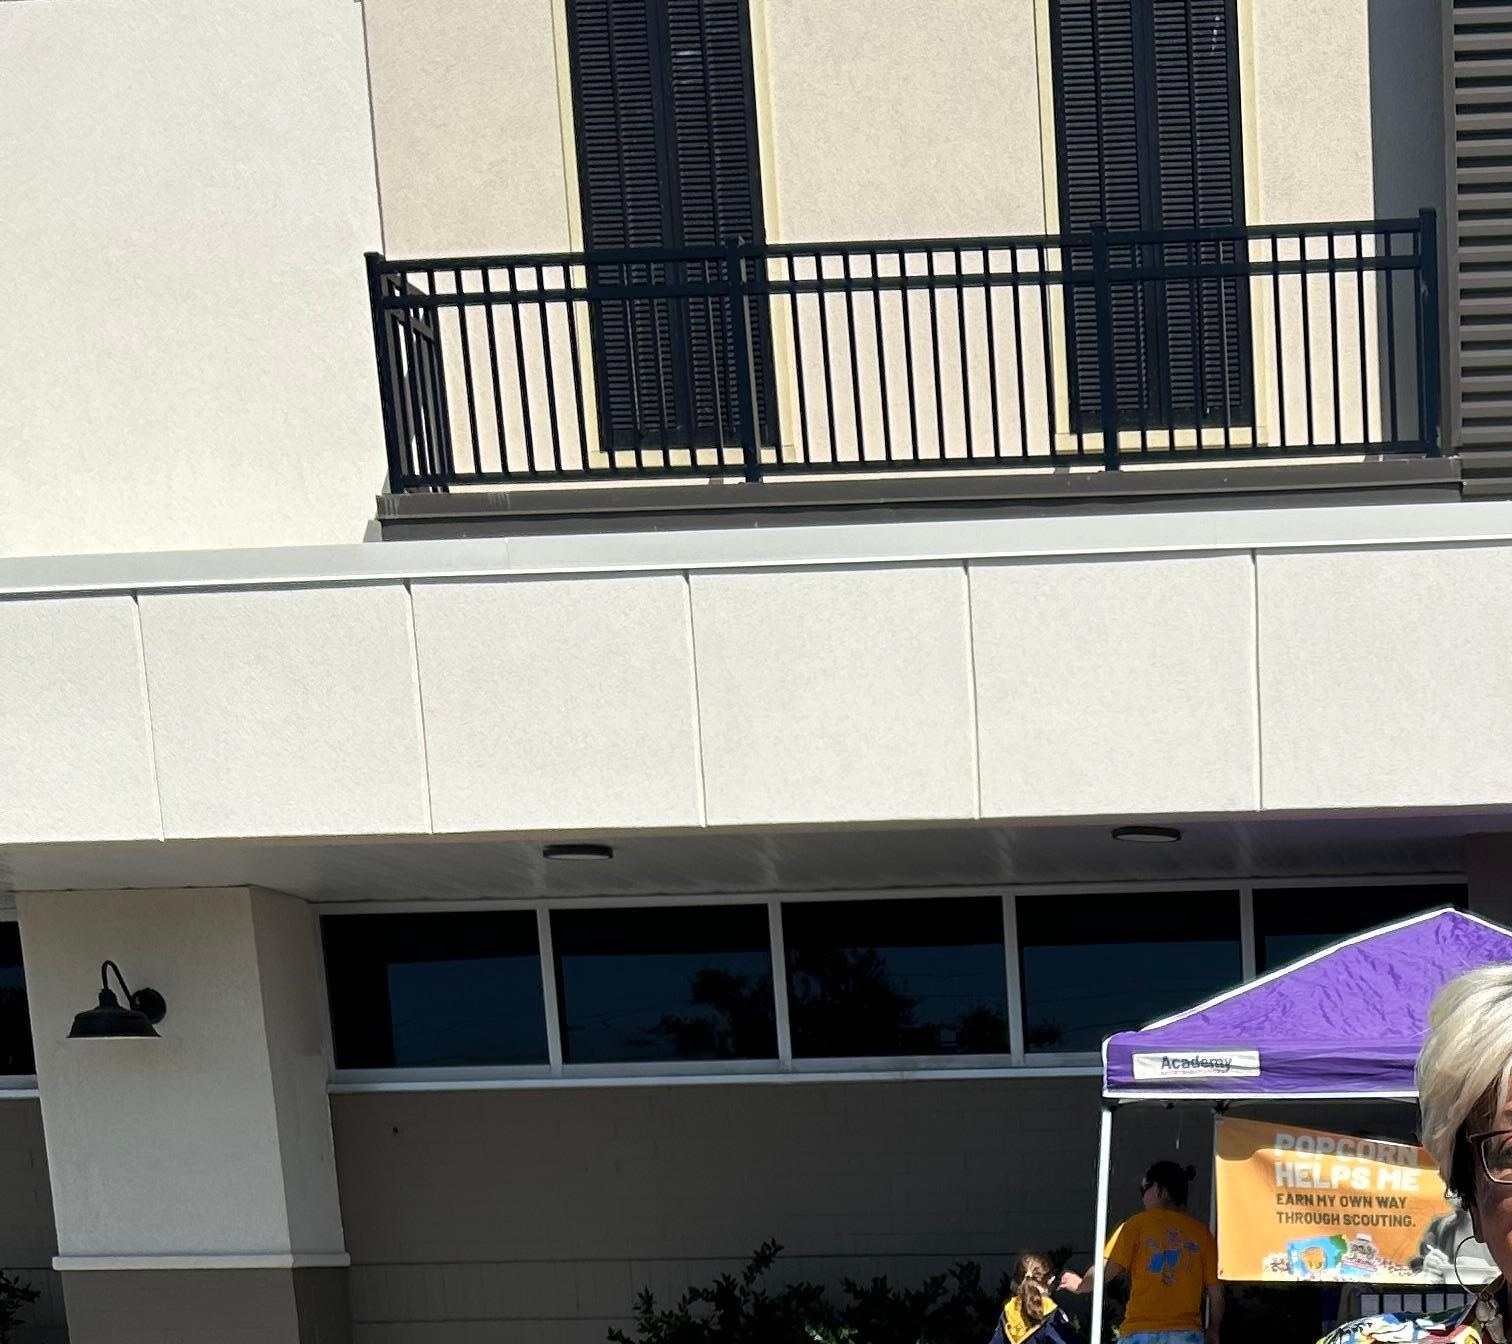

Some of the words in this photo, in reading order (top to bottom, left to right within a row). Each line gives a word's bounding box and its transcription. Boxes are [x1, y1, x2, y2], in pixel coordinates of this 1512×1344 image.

[1161, 1055, 1232, 1073] Academy
[1275, 1132, 1418, 1166] POPCORN
[1276, 1161, 1370, 1190] HELPS
[1377, 1167, 1421, 1191] ME
[1276, 1192, 1314, 1207] EARN
[1316, 1195, 1336, 1208] MY
[1339, 1196, 1373, 1208] OWN
[1375, 1196, 1407, 1209] WAY
[1276, 1211, 1340, 1225] THROUGH
[1343, 1213, 1417, 1227] SCOUTING.
